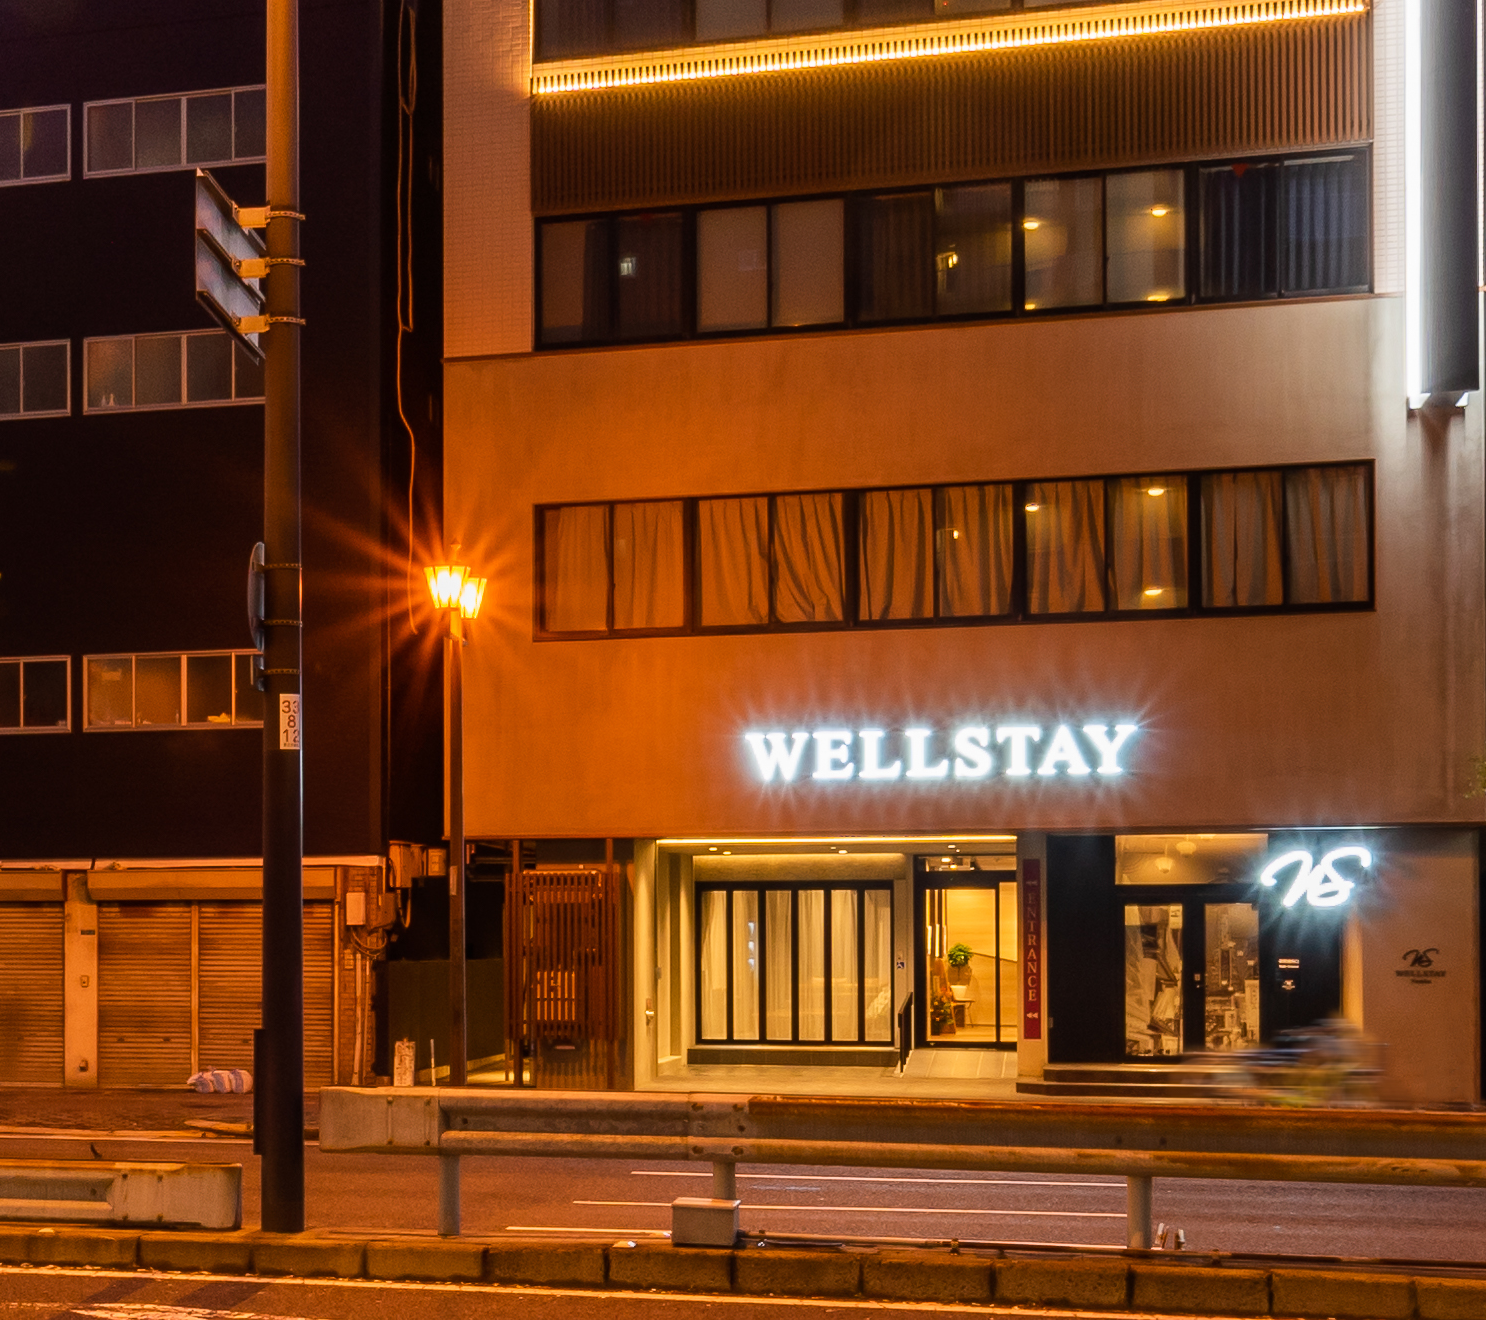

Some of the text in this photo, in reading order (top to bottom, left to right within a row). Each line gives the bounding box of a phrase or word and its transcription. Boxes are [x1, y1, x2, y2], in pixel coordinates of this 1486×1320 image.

[287, 714, 296, 728] 8
[744, 725, 1138, 781] WELLSTAY
[1026, 892, 1038, 1002] ENTRANCE
